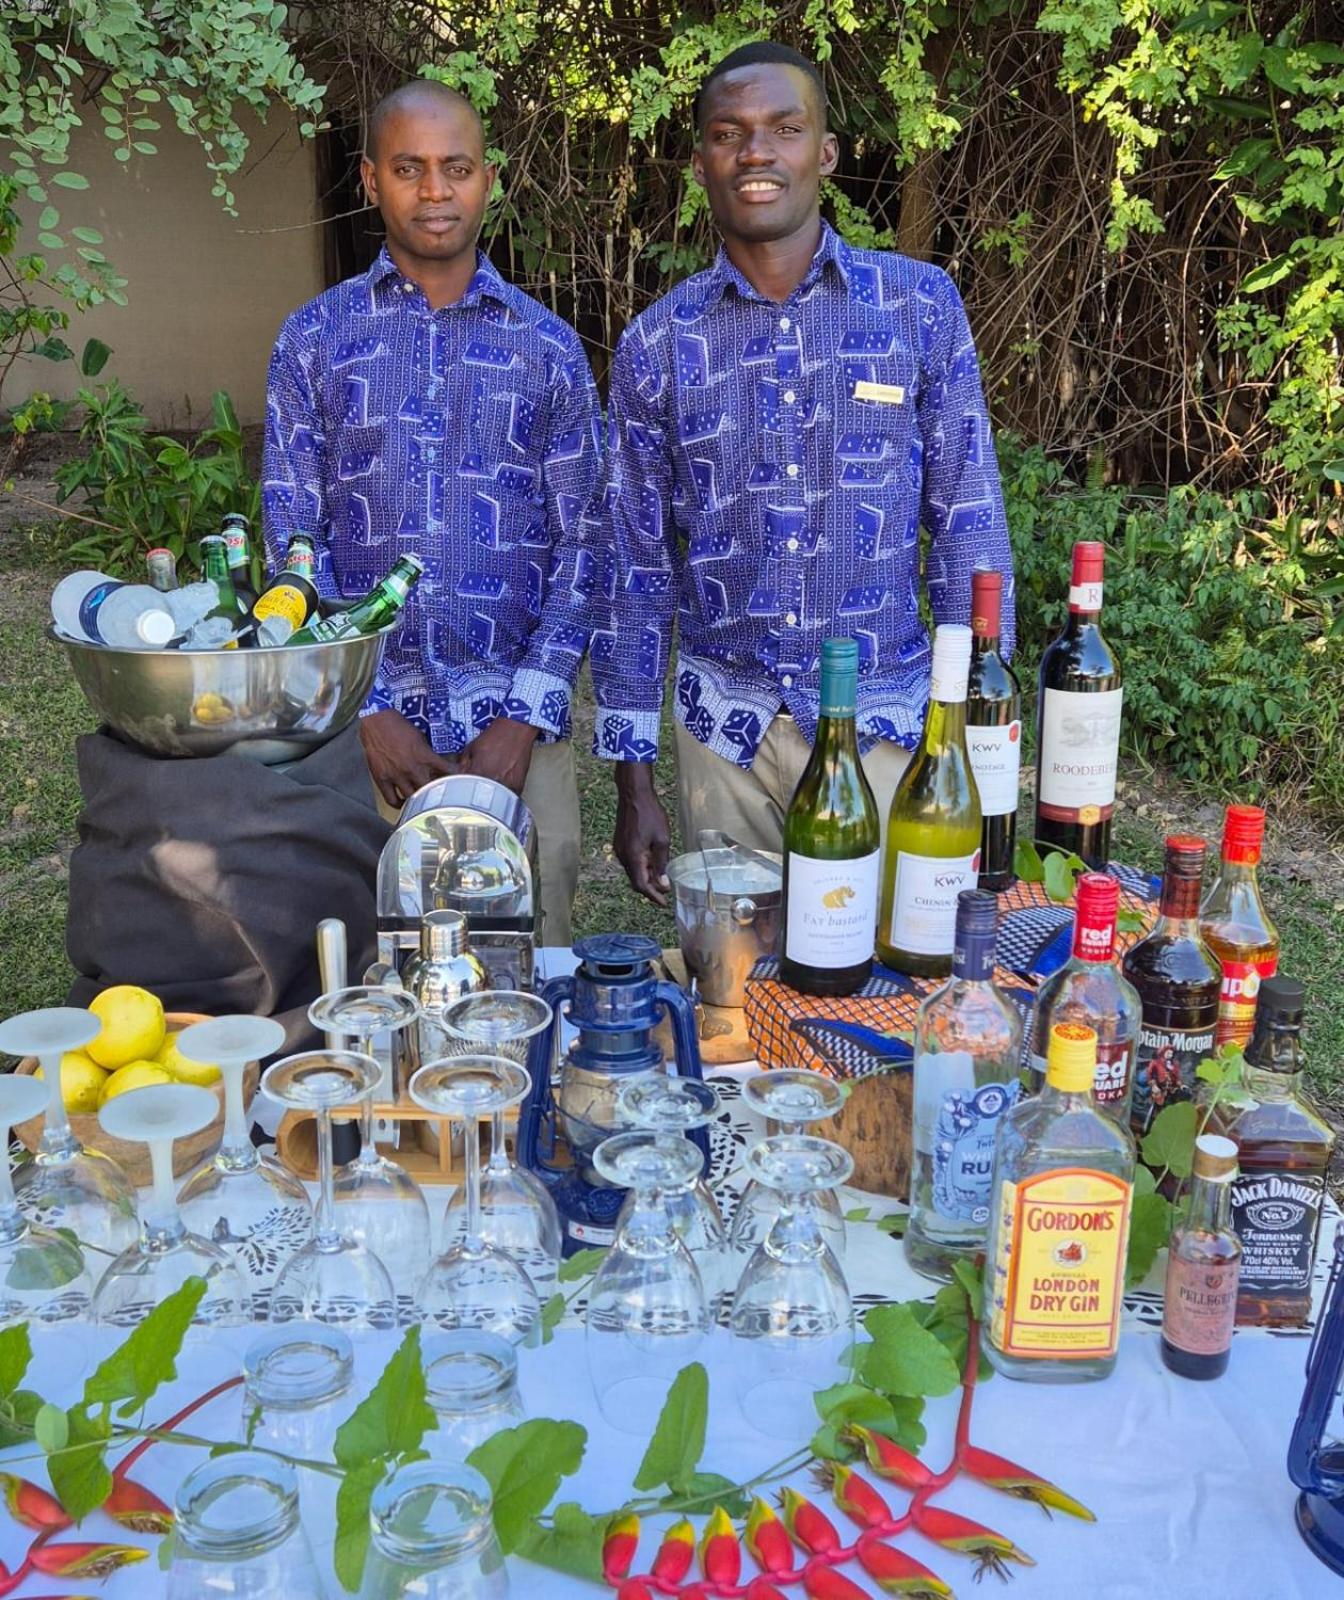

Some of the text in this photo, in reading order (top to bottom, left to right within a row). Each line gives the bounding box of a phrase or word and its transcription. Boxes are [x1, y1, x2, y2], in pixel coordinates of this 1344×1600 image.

[227, 536, 245, 546] OSI
[1088, 588, 1099, 603] R
[972, 743, 1001, 752] KWV
[934, 876, 965, 887] KWV
[1081, 924, 1113, 941] red
[1139, 1030, 1214, 1053] ptain Morgan
[1094, 1051, 1129, 1081] ed
[1096, 1078, 1126, 1091] UARE
[1098, 1090, 1124, 1100] DKA
[962, 1151, 993, 1161] WHI
[961, 1161, 992, 1175] RU
[1231, 1183, 1269, 1207] JACK
[1027, 1207, 1115, 1232] GORDON'S
[1242, 1228, 1303, 1241] Tennessee
[1242, 1247, 1301, 1256] WHISKEY
[1033, 1278, 1100, 1292] LONDON
[1030, 1294, 1100, 1312] DRY GIN
